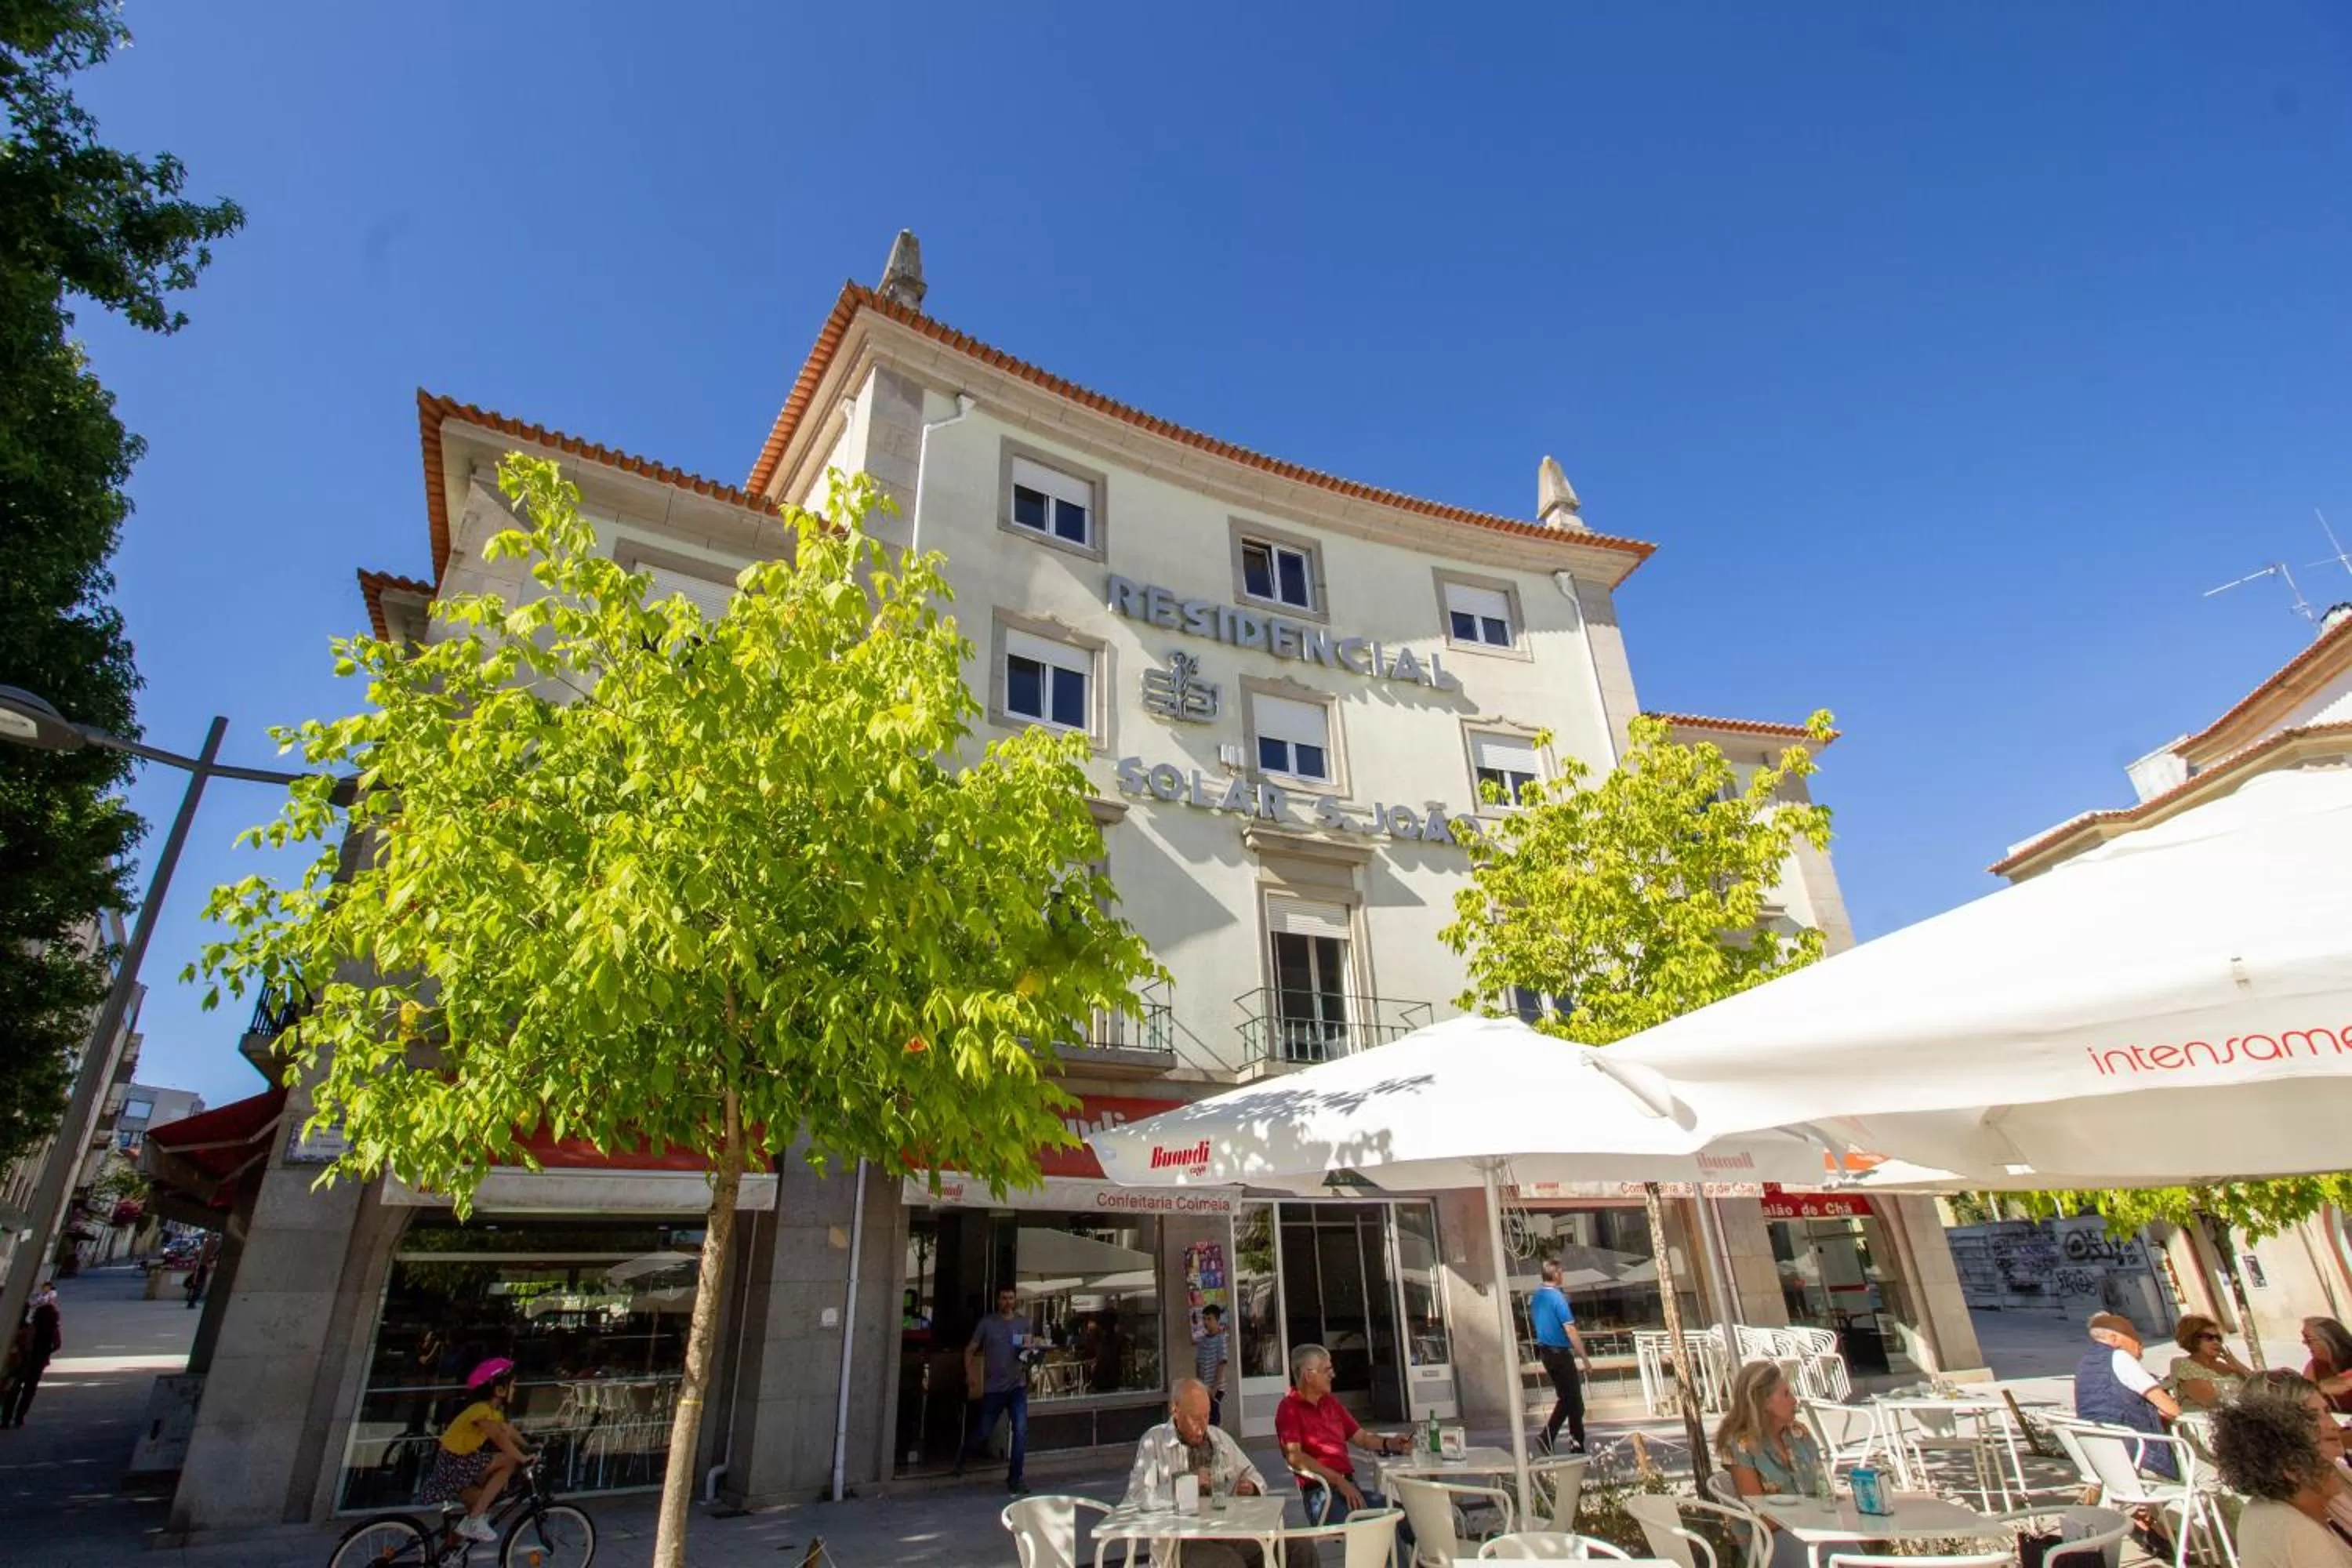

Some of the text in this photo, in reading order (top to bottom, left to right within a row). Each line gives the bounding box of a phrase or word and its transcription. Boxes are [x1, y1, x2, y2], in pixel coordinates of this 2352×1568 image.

[1108, 574, 1458, 691] RESIDENCIAL
[1116, 756, 1287, 822] SOLAR
[1097, 1192, 1173, 1210] Confeitaria
[1762, 1201, 1853, 1216] alão de Chá
